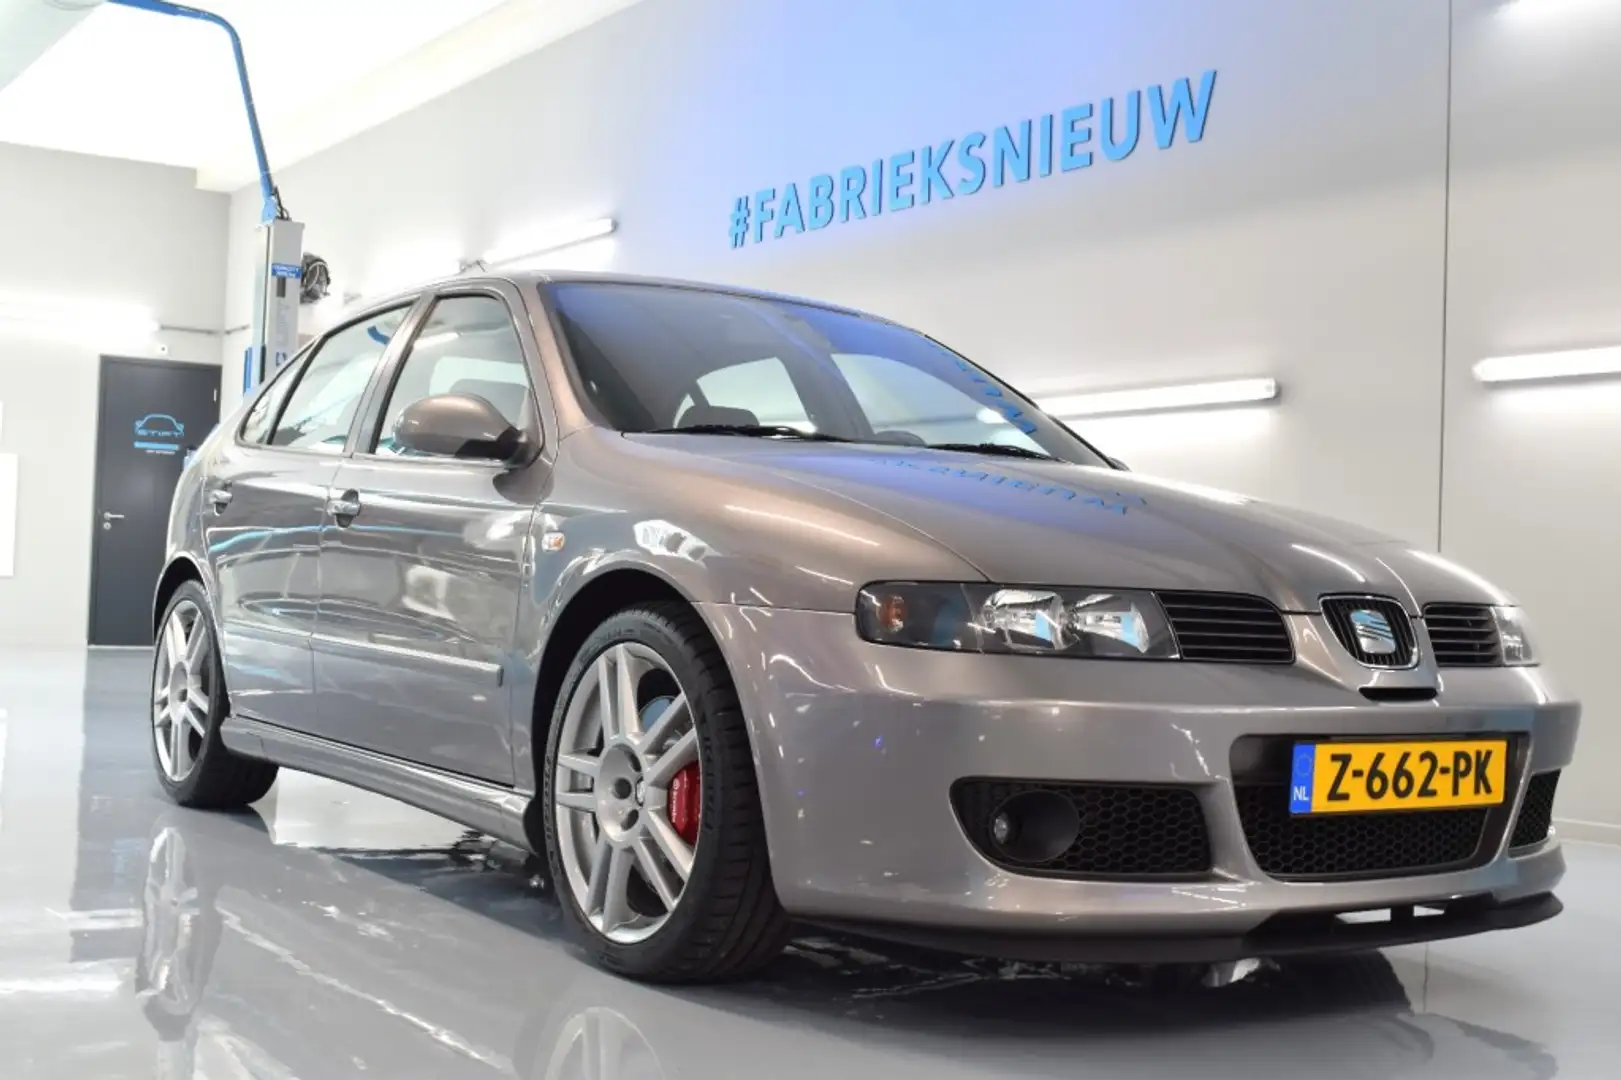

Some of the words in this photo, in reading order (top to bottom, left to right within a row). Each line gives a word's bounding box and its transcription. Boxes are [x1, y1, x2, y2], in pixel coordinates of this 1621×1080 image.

[728, 69, 1218, 249] #FABRIEKSNIEUW
[1293, 786, 1309, 801] NL
[1327, 749, 1493, 801] Z-662-PK
